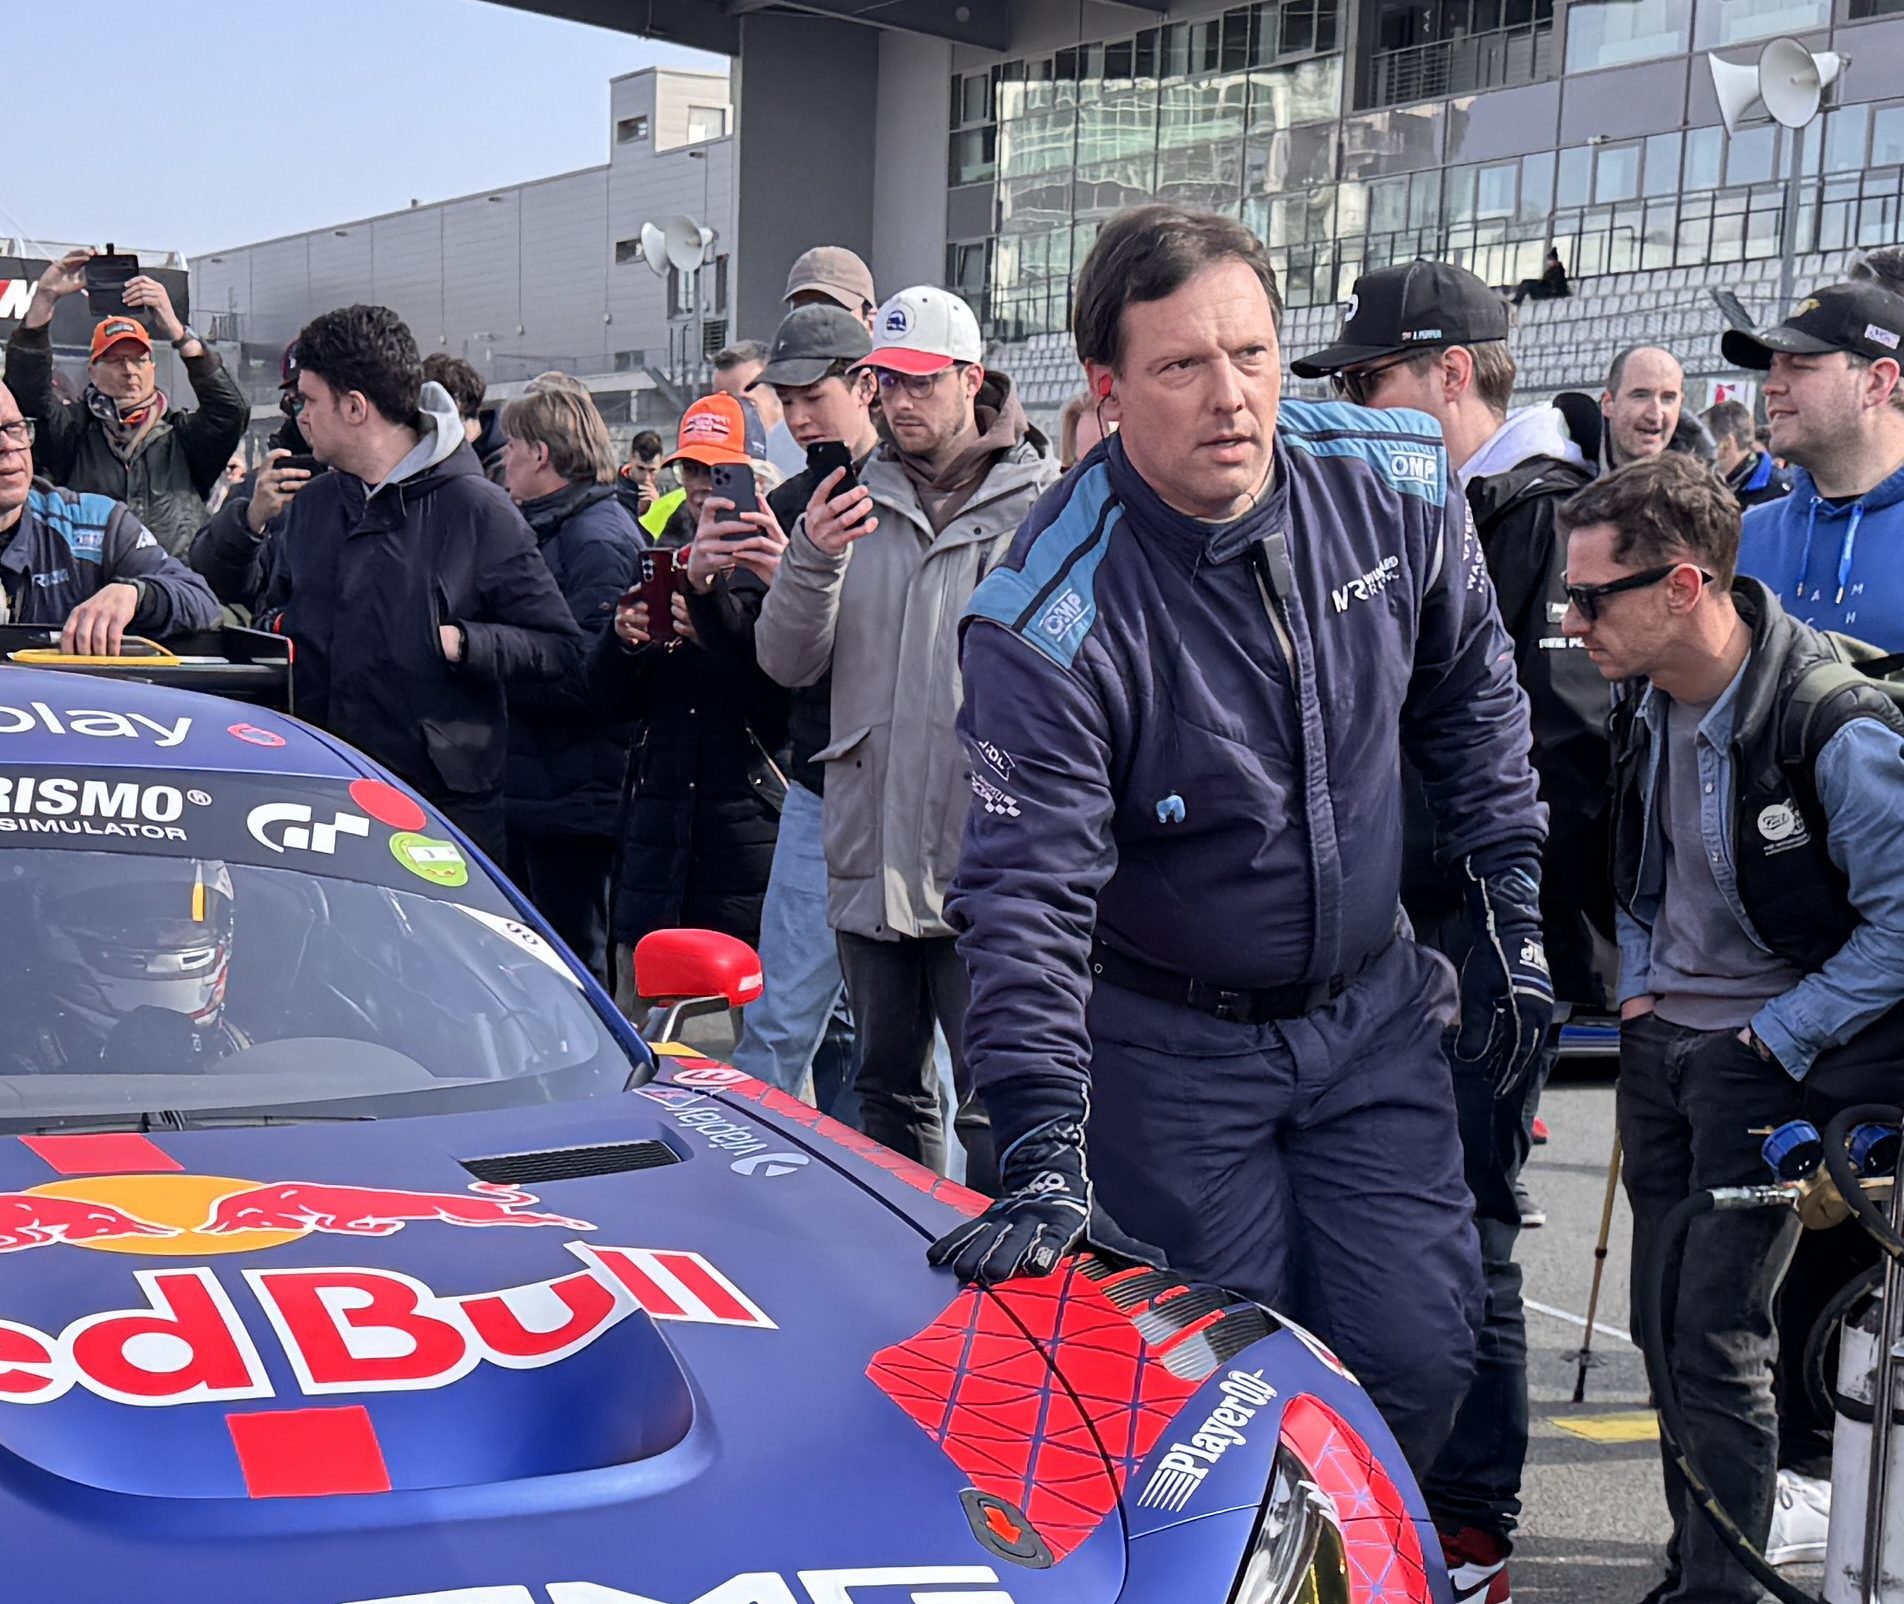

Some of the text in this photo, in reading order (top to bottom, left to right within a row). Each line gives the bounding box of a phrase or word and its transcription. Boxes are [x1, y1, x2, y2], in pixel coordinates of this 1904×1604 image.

[1392, 455, 1437, 480] OMP
[678, 1106, 769, 1157] viaplay
[246, 1243, 773, 1395] Bull
[1158, 1396, 1256, 1480] Player
